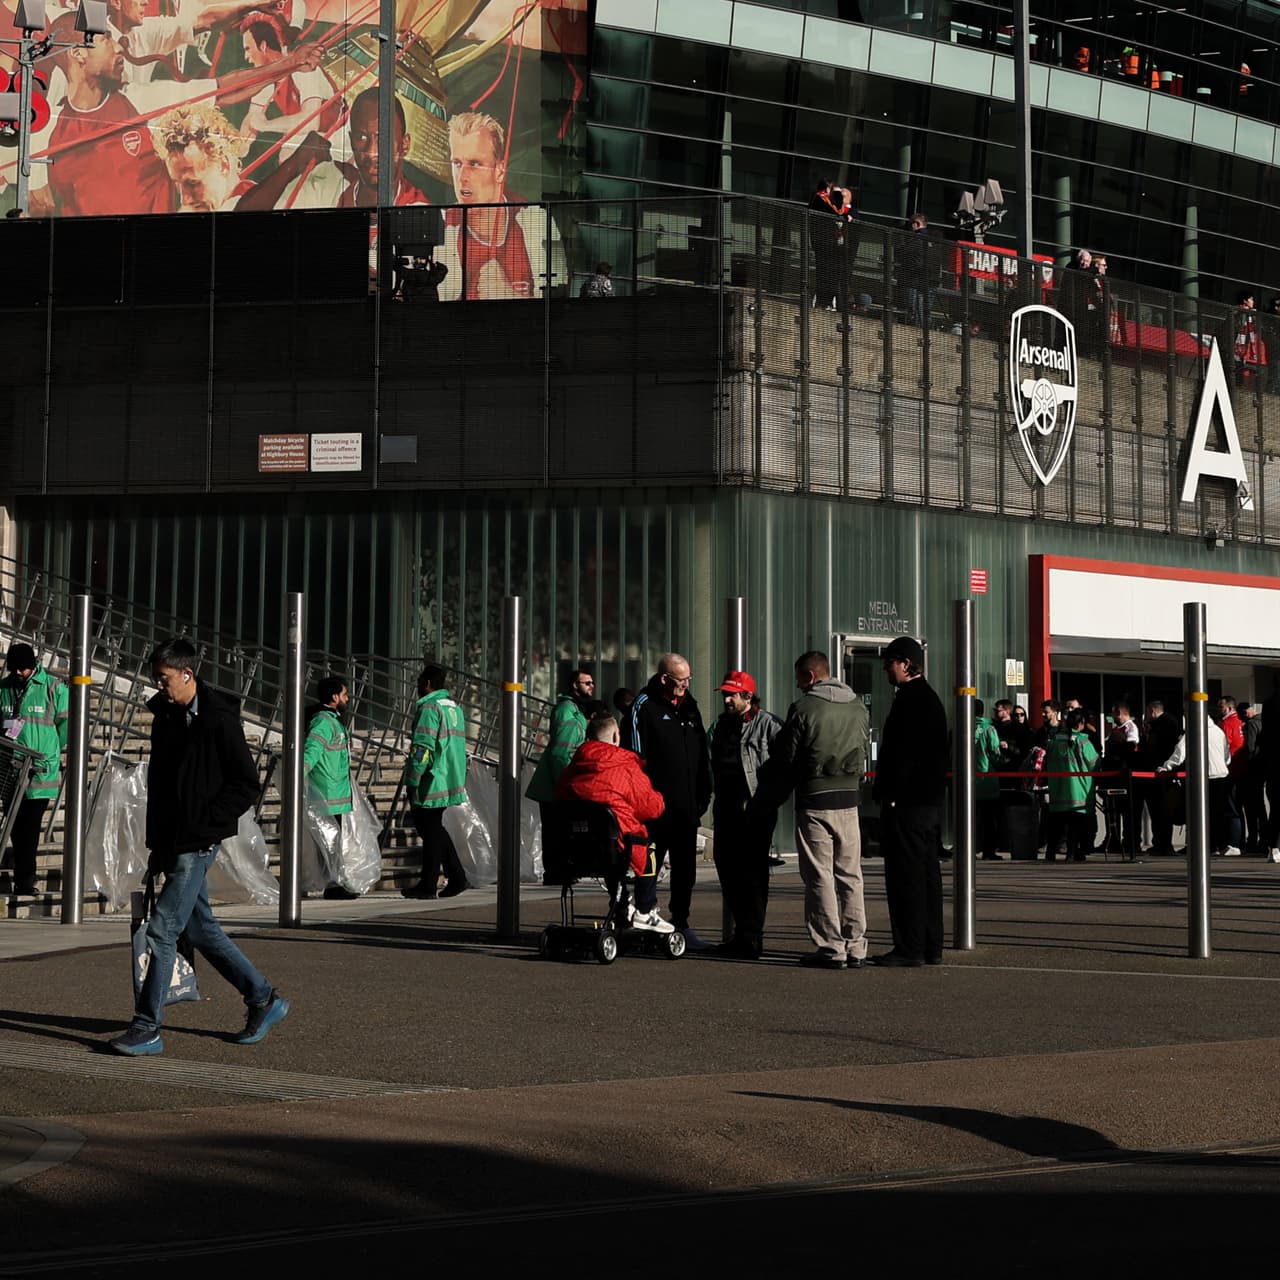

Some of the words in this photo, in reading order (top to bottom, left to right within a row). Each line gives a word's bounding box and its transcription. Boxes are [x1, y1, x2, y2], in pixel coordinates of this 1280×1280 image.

[1019, 337, 1069, 371] Arsenal
[868, 601, 898, 617] MEDIA
[858, 616, 910, 633] ENTRANCE
